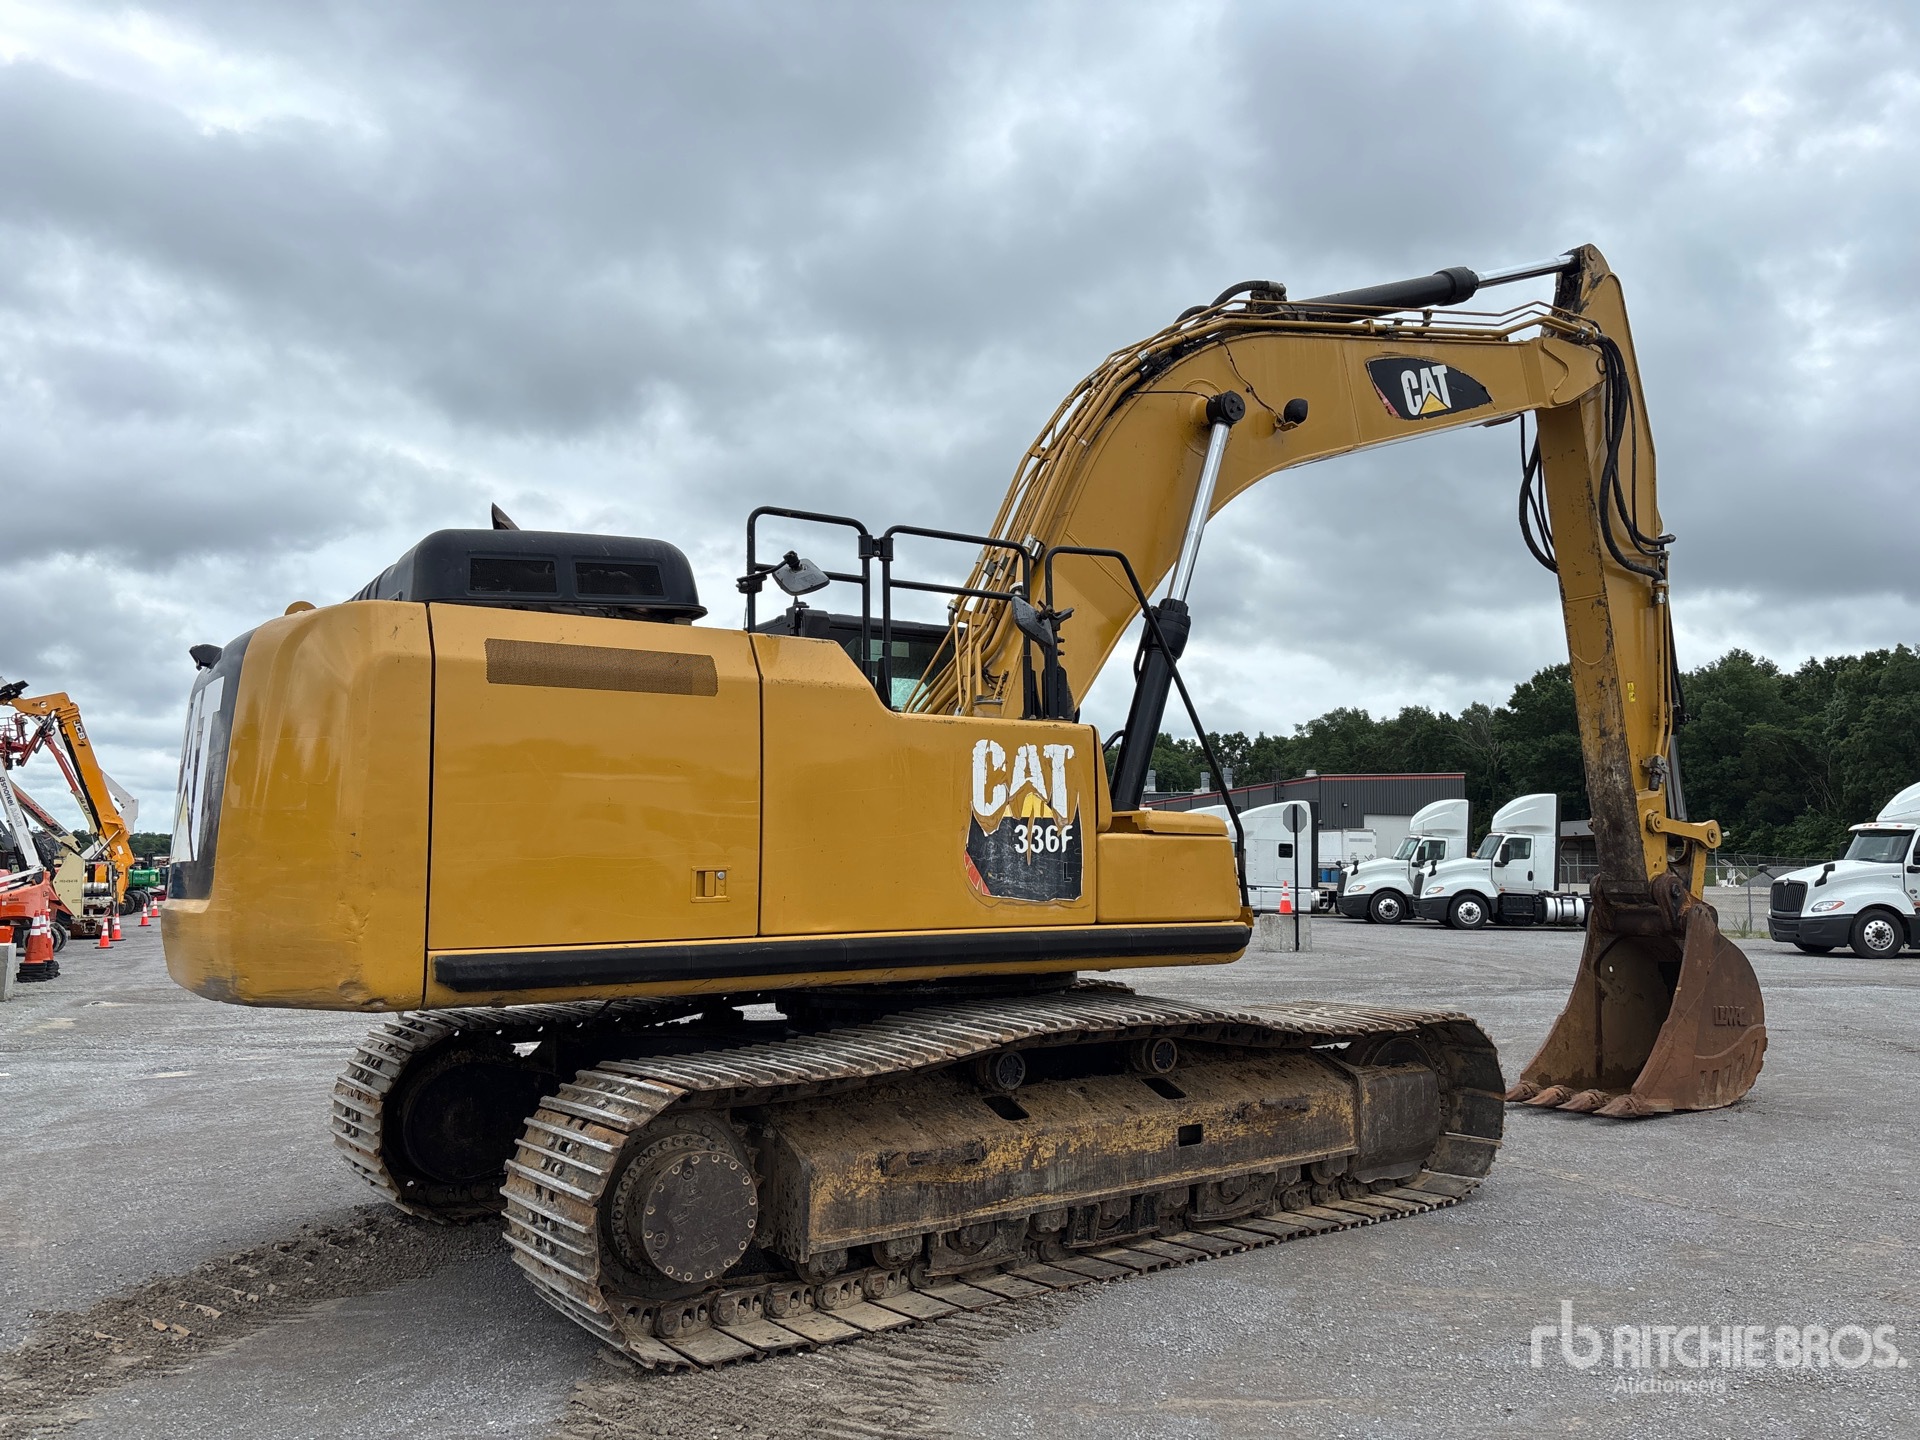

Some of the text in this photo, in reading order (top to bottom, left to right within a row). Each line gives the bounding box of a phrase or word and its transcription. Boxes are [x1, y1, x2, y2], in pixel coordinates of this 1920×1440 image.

[1400, 364, 1452, 416] CAT
[73, 720, 86, 740] JCB
[171, 676, 225, 862] AT
[972, 739, 1074, 819] CAT
[1014, 824, 1073, 853] 336F
